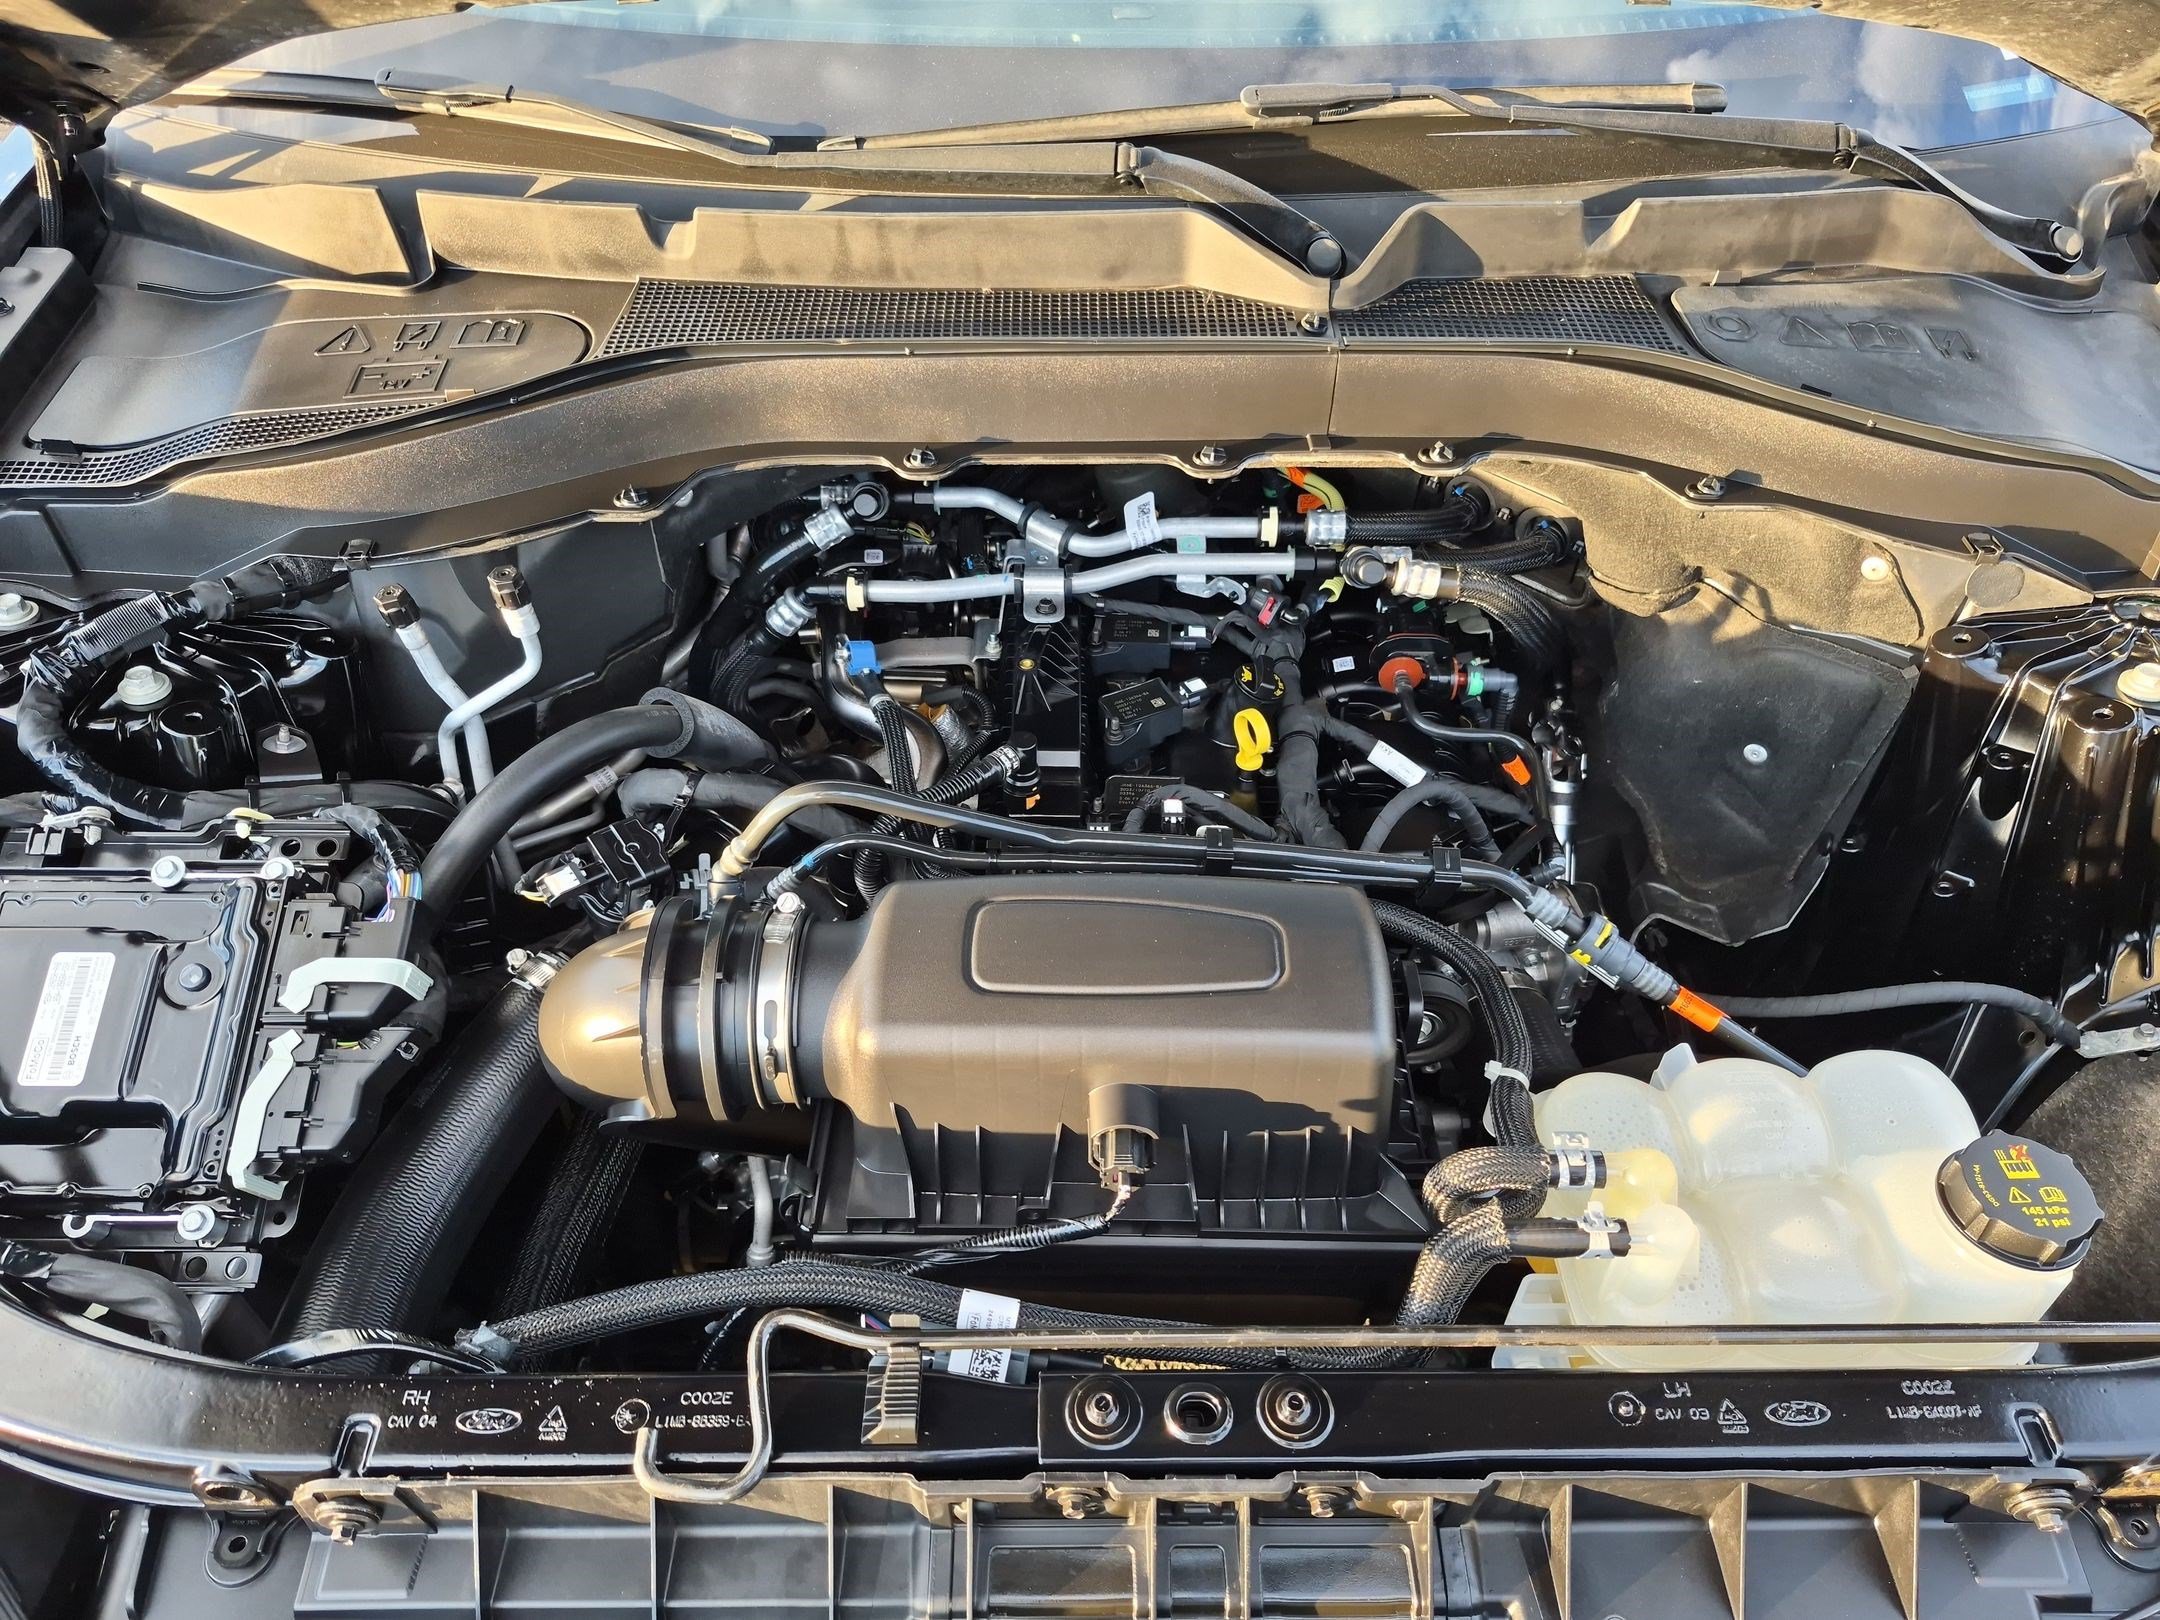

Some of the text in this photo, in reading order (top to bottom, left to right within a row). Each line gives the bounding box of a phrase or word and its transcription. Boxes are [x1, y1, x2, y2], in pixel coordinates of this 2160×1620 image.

[67, 1035, 81, 1066] BOSCH
[2022, 1205, 2069, 1215] 145 kPa
[2033, 1217, 2071, 1228] 21 psi
[1663, 1381, 1691, 1398] LH
[402, 1389, 431, 1406] RH
[1655, 1407, 1710, 1420] CAV 03
[387, 1414, 438, 1429] CAV 04
